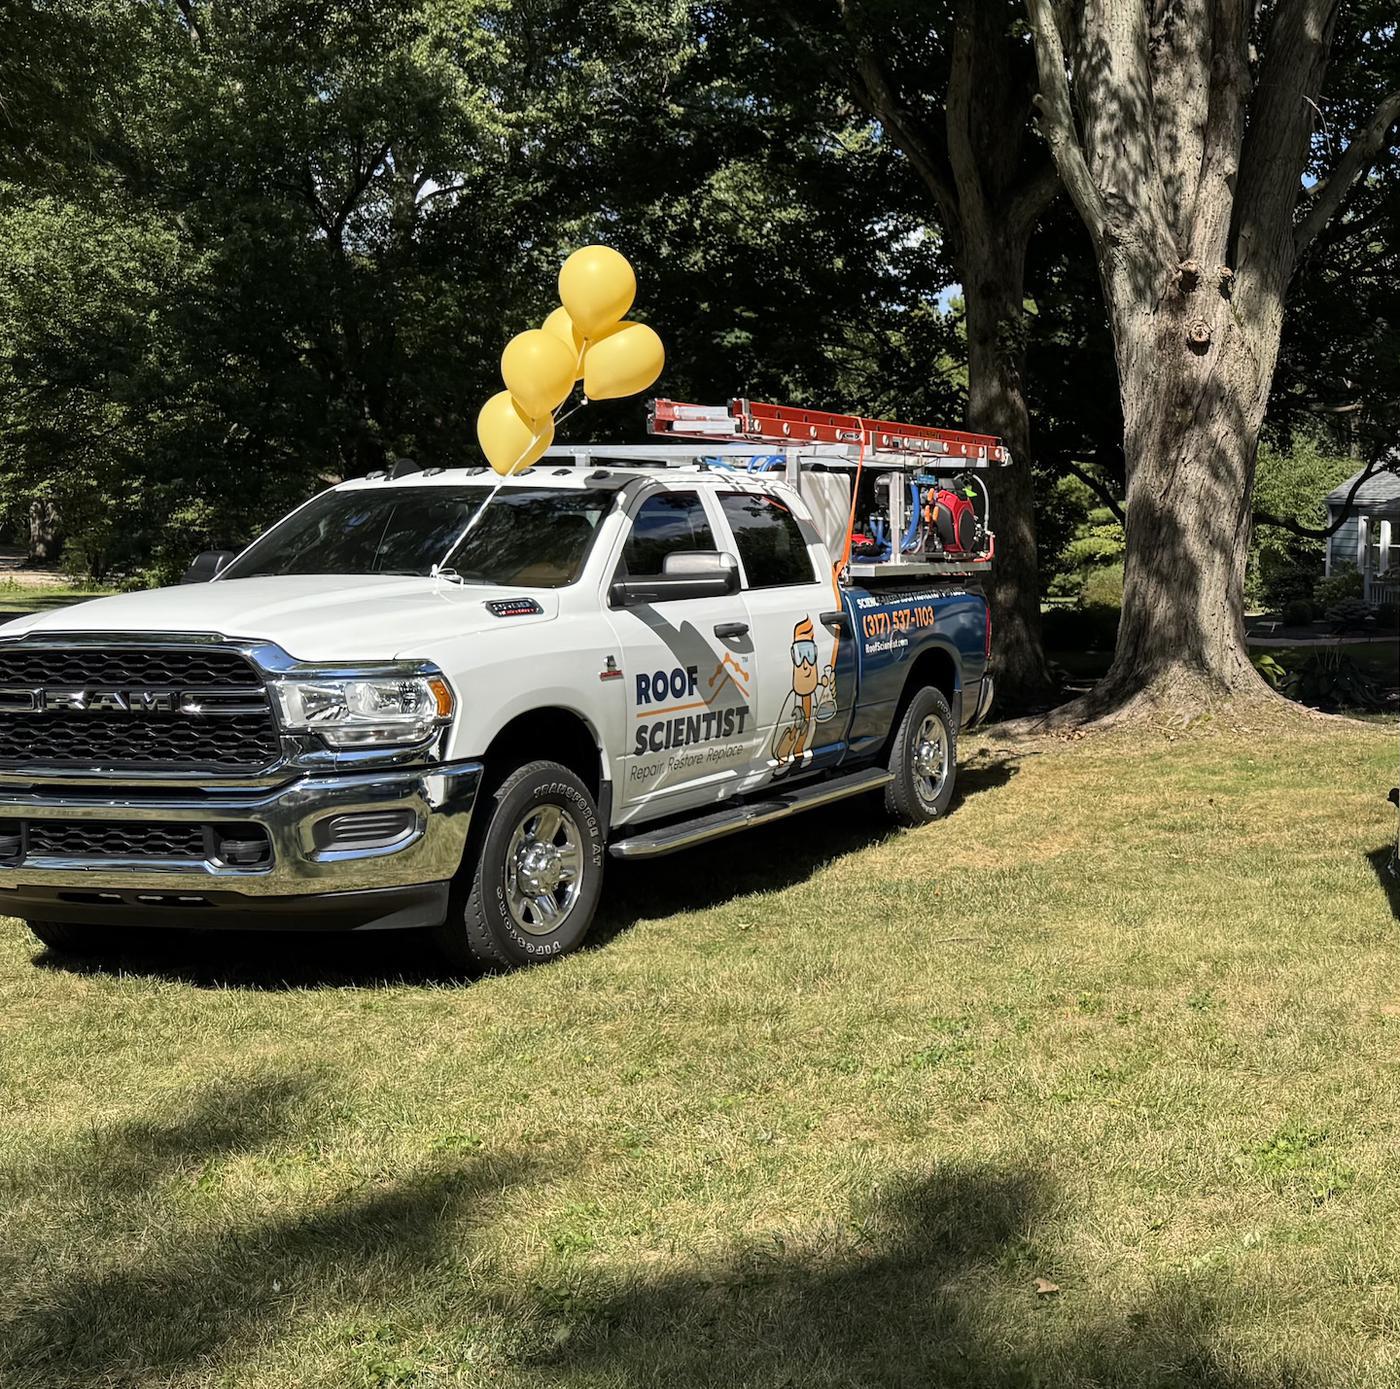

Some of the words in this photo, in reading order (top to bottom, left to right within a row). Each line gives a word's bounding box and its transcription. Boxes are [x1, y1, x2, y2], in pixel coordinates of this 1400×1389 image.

[862, 612, 891, 638] (317)
[892, 605, 935, 631] 537-1103
[46, 691, 174, 711] RAM
[635, 666, 698, 705] ROOF
[633, 705, 750, 756] SCIENTIST
